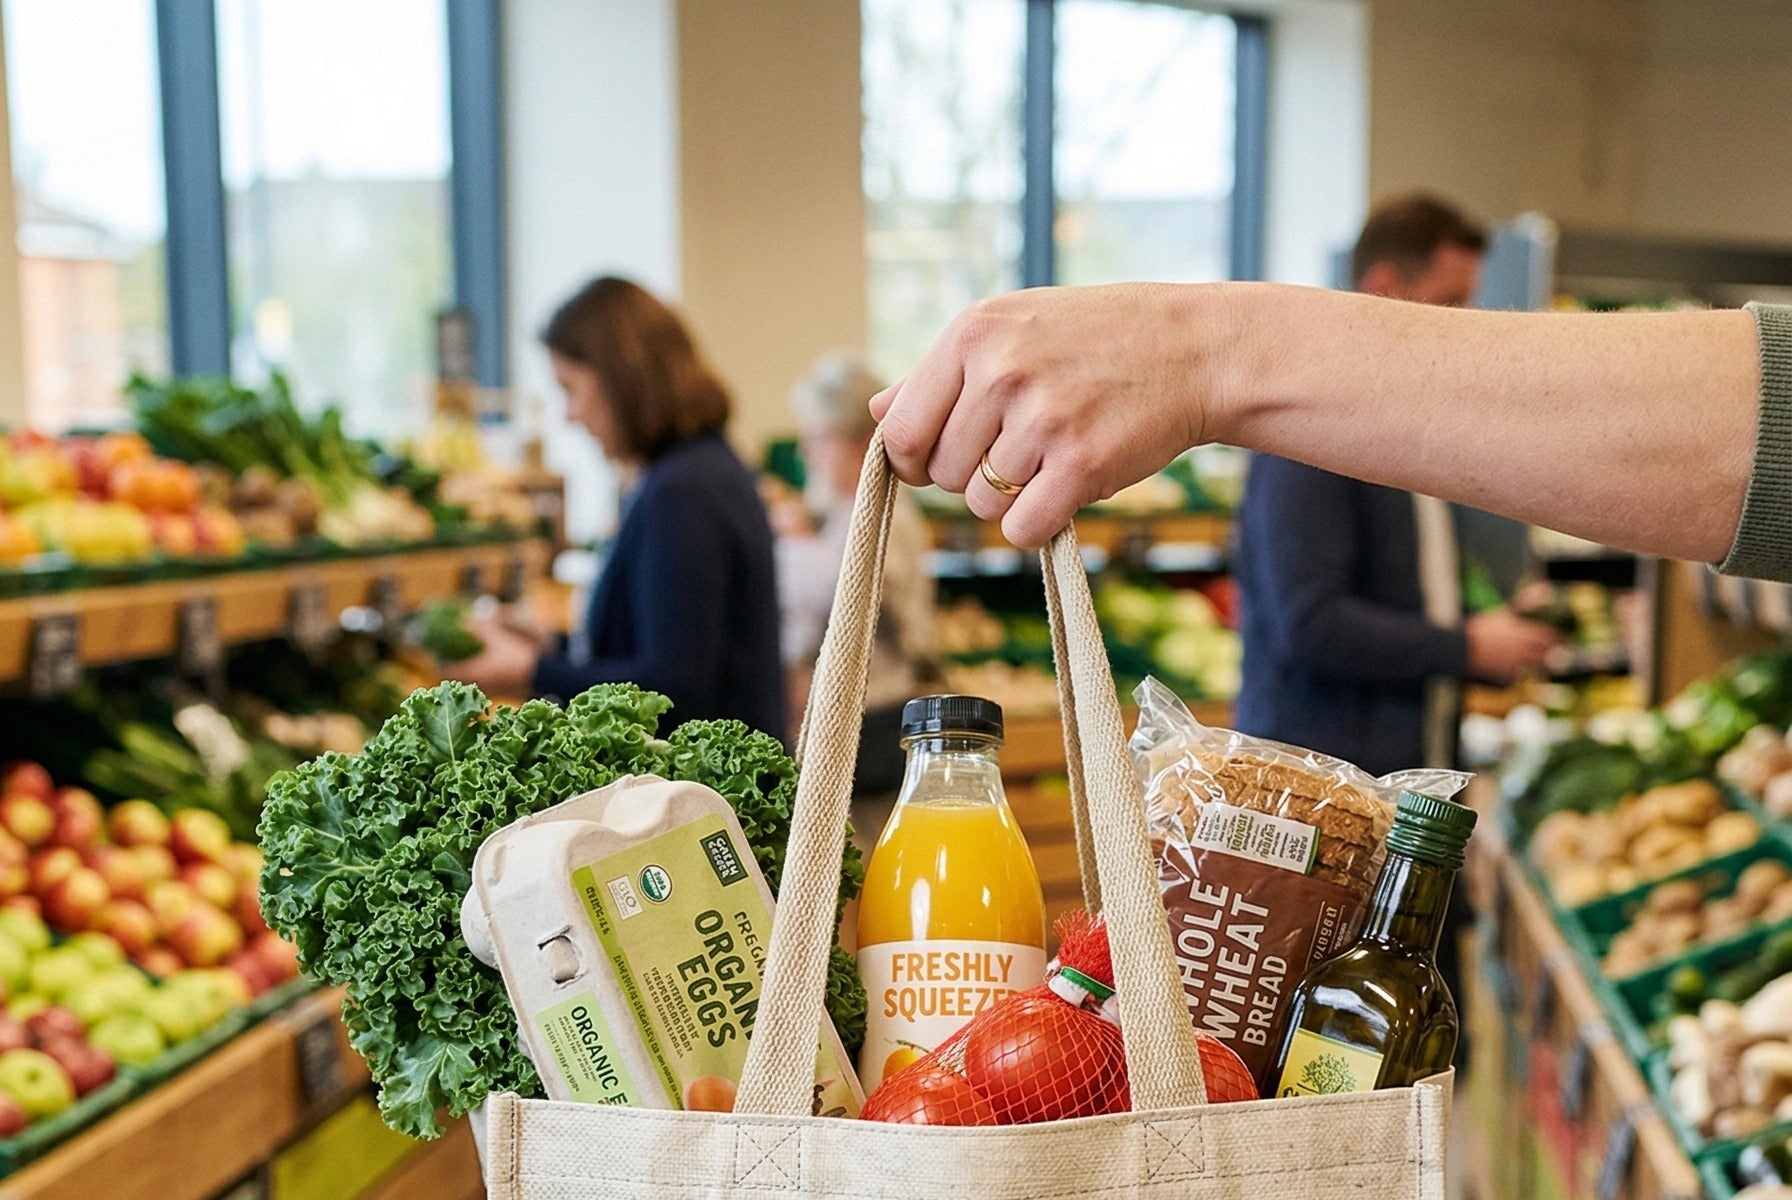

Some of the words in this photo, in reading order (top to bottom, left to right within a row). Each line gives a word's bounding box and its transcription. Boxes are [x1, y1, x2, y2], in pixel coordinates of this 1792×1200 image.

[676, 954, 737, 1048] EGGS
[694, 910, 759, 1040] ORGAN
[884, 987, 1019, 1023] SQUEEZ
[891, 952, 1013, 983] FRESHLY
[1202, 892, 1269, 1039] WHEAT
[1242, 955, 1287, 1047] BREAD
[571, 1005, 619, 1090] ORGANIC
